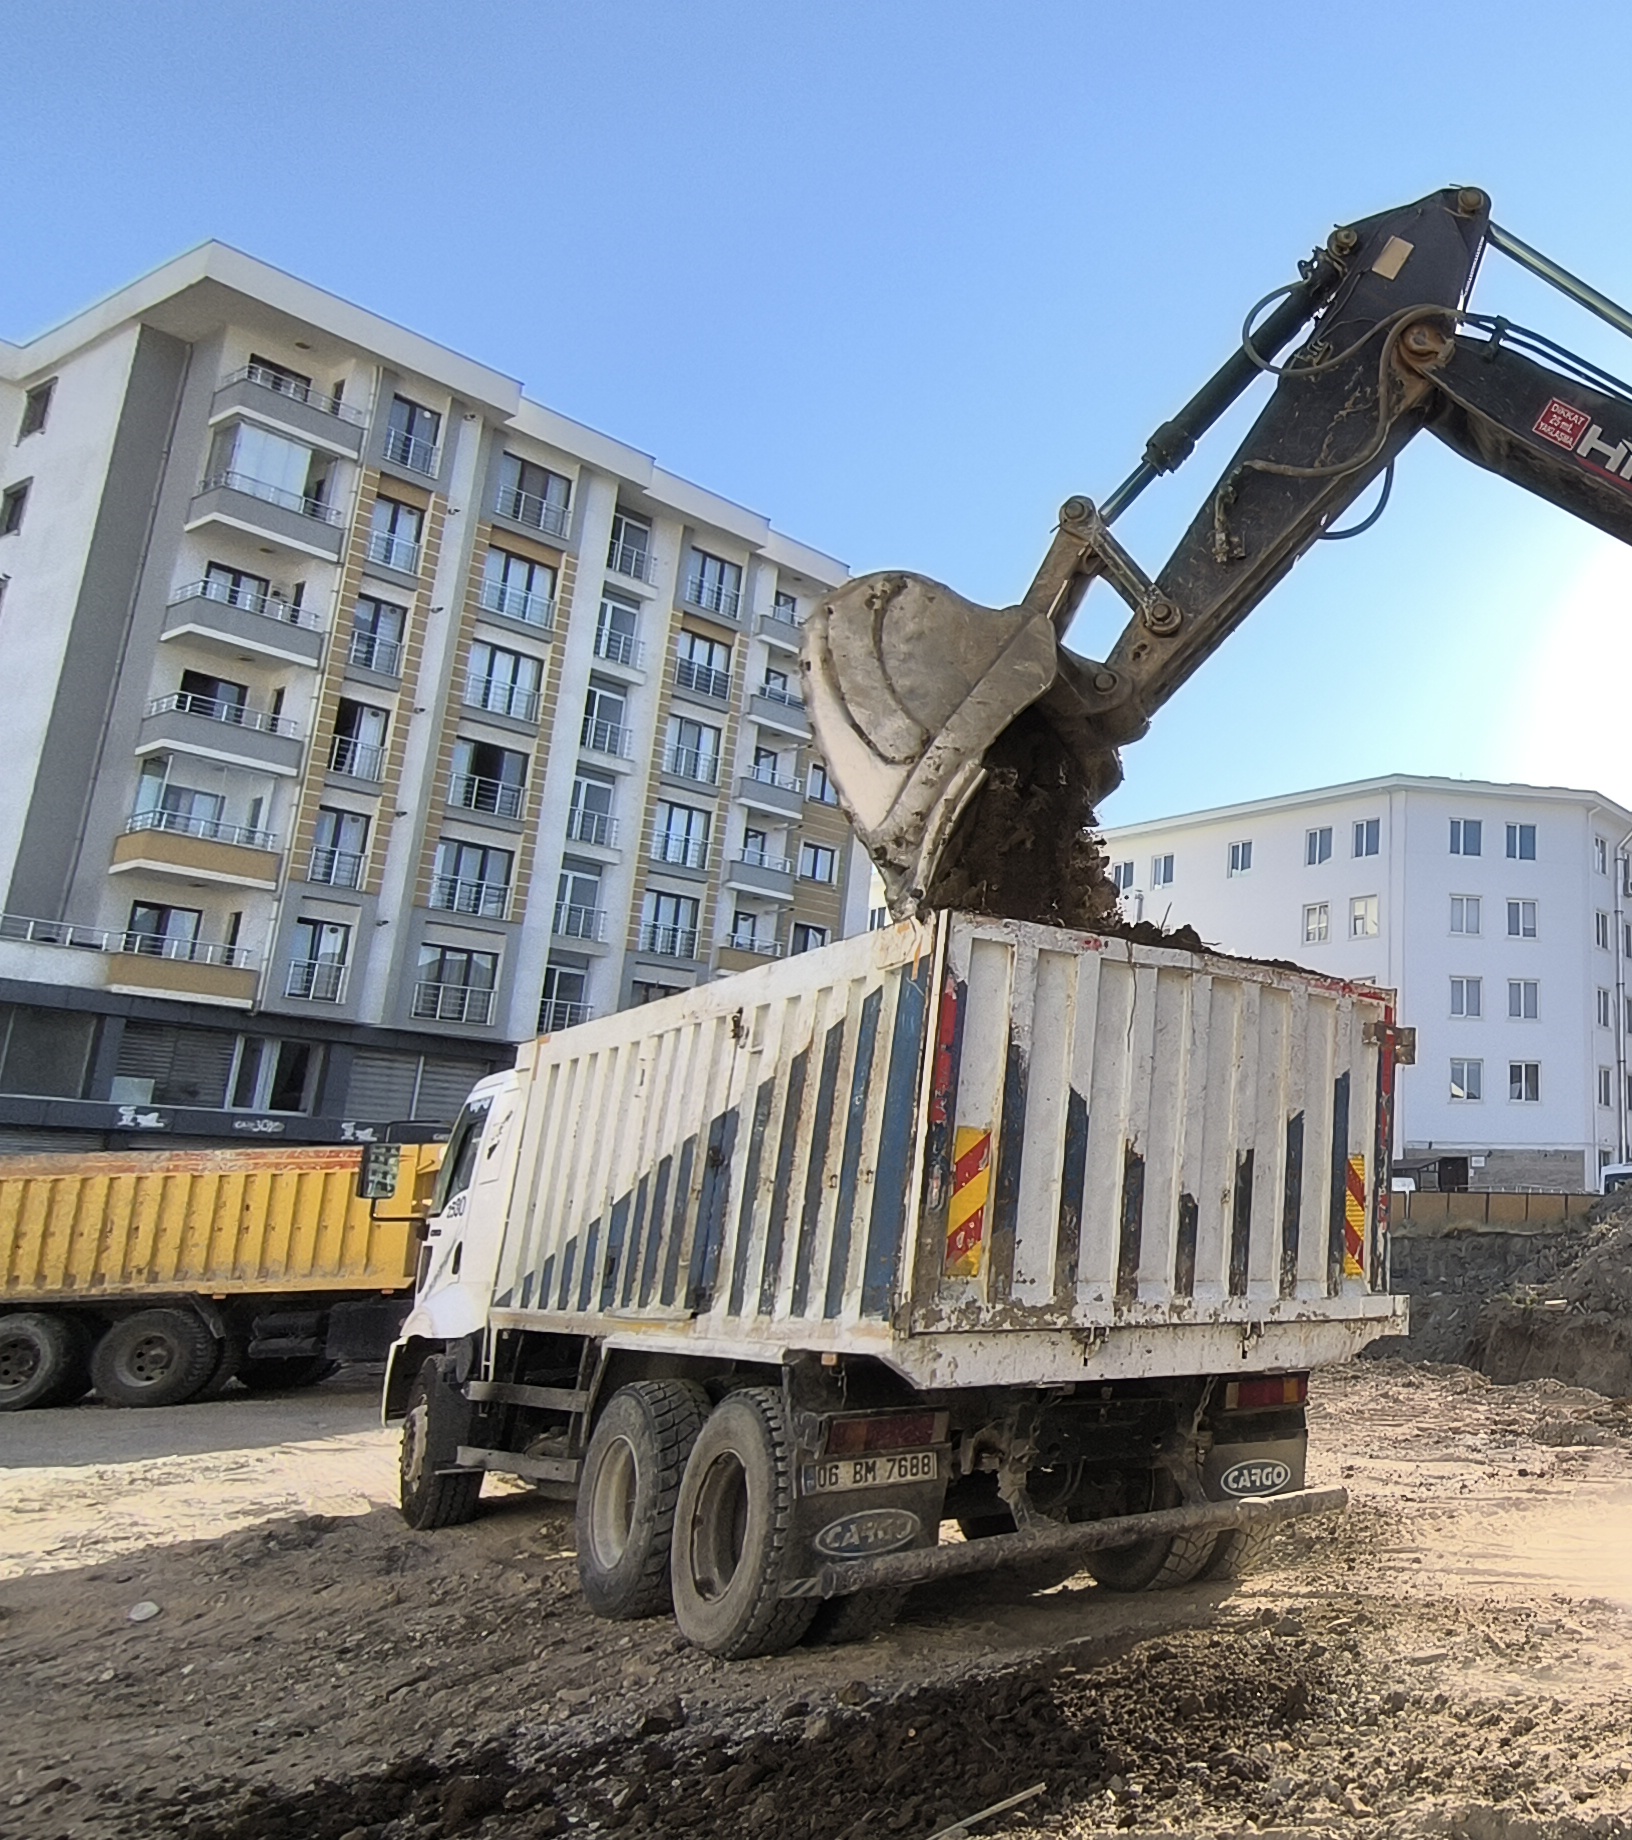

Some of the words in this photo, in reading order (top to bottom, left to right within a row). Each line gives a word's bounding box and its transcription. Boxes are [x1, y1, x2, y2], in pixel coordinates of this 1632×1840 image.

[1549, 414, 1562, 427] 25
[817, 1464, 839, 1488] 06
[852, 1460, 876, 1484] BM
[886, 1454, 931, 1480] 7688
